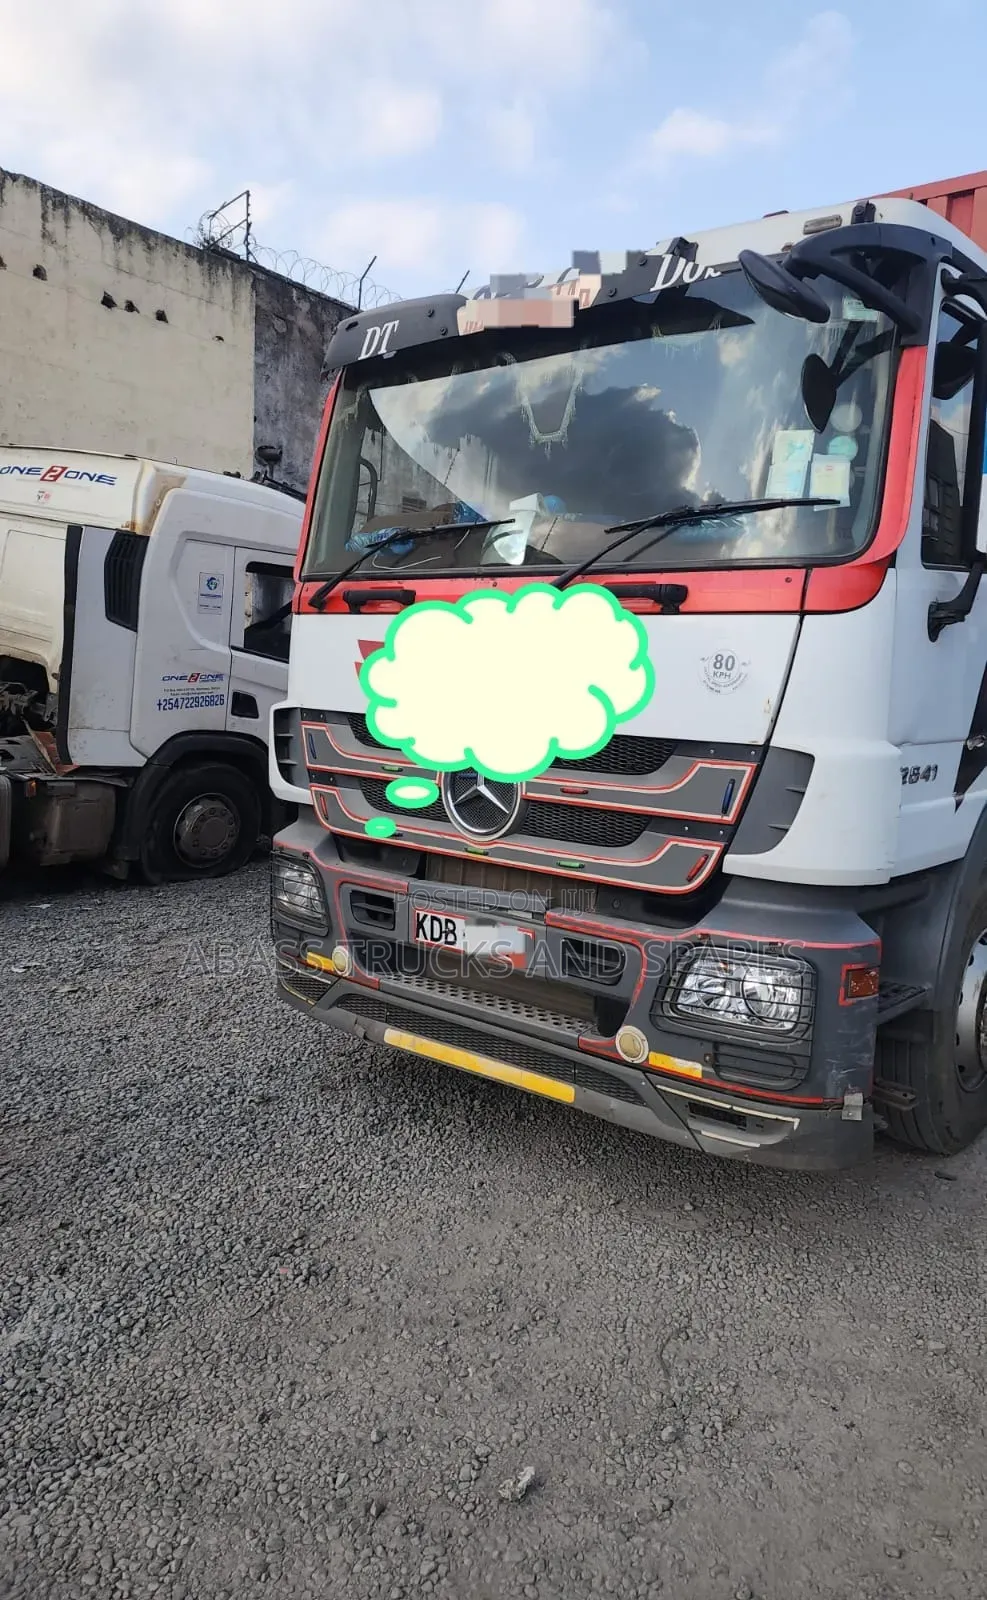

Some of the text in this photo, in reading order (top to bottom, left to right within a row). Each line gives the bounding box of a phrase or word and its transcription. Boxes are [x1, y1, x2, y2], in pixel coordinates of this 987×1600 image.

[357, 319, 400, 360] DT
[713, 653, 735, 671] 80
[713, 670, 731, 680] KPH
[156, 694, 225, 712] +254722926826
[414, 911, 458, 946] KDB
